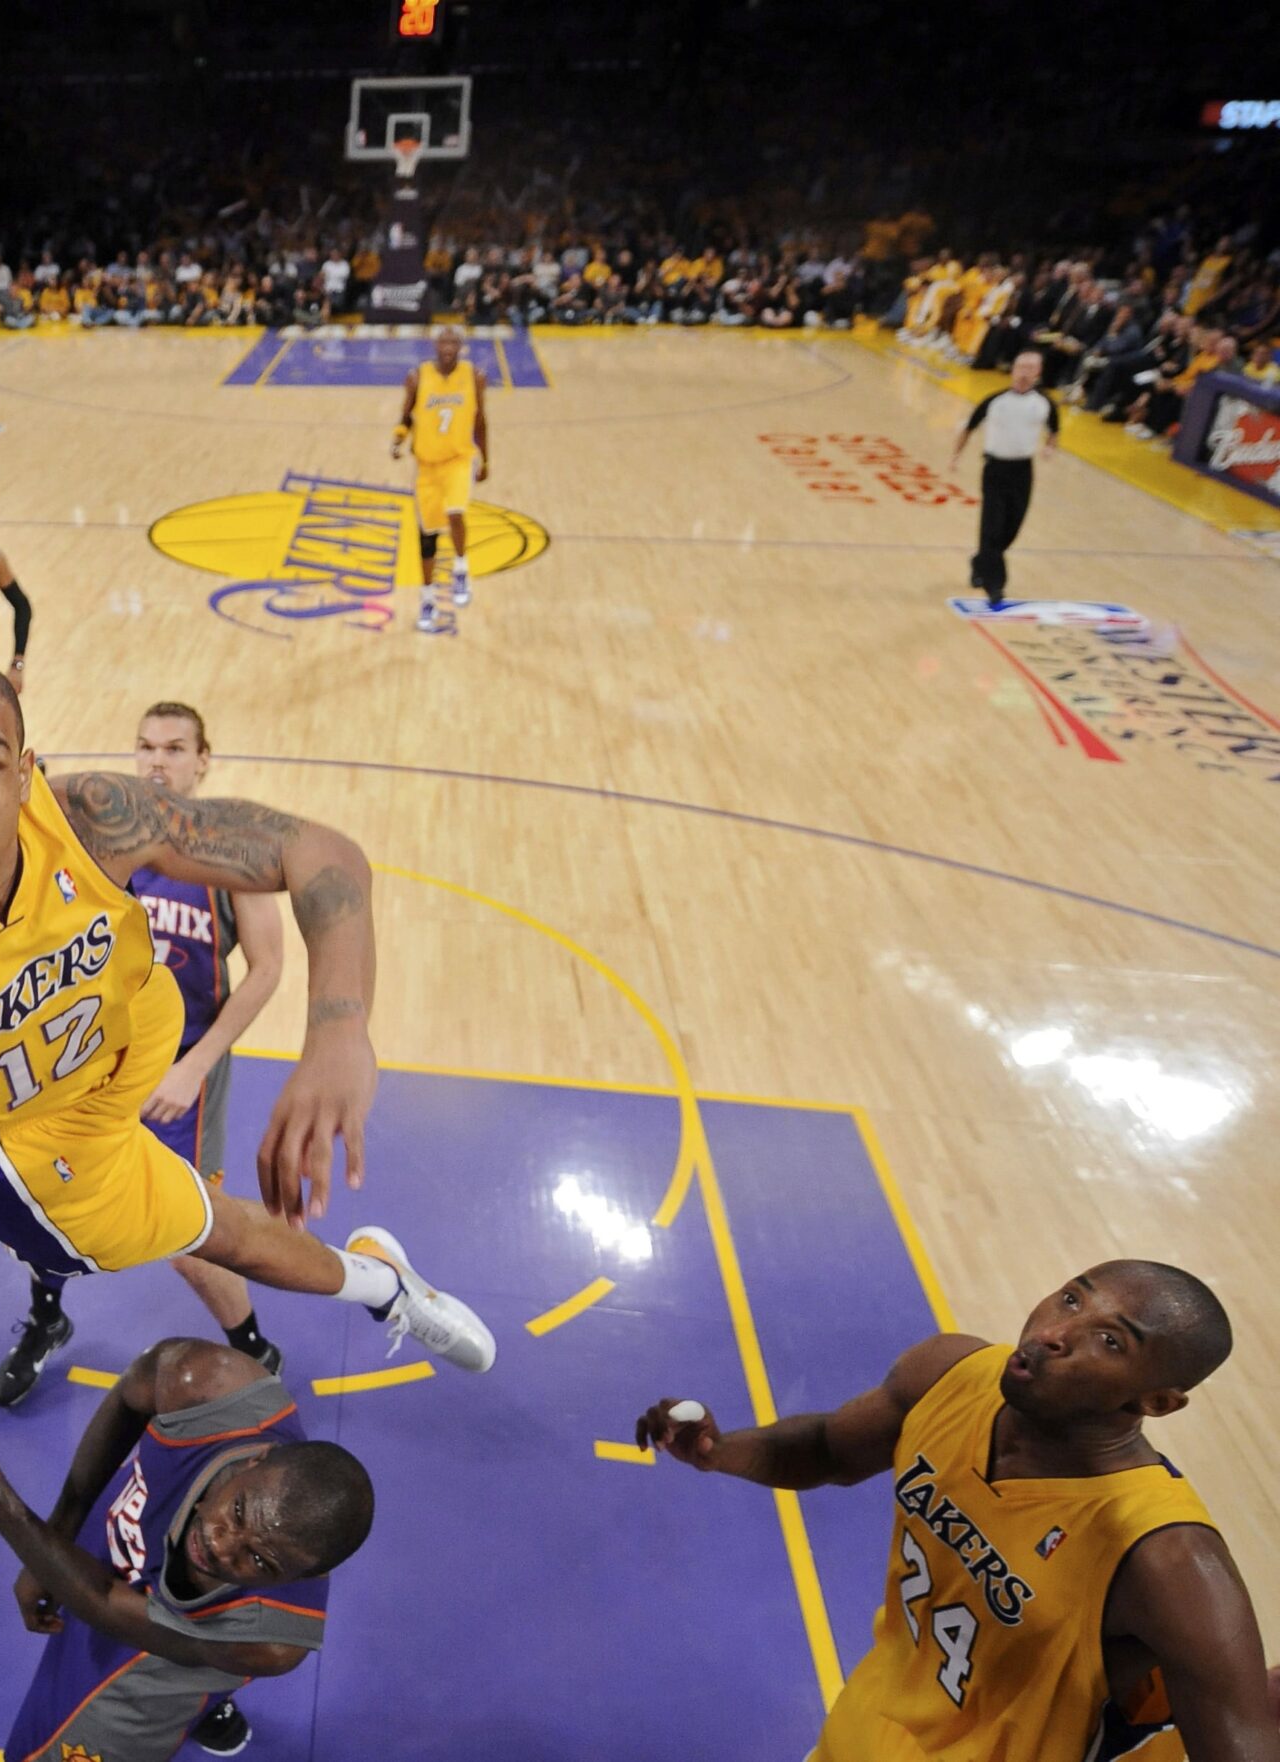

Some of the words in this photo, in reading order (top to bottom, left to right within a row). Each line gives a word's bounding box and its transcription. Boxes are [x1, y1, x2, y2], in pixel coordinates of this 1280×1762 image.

[438, 407, 453, 434] 7
[208, 467, 417, 640] LAKERS
[1090, 625, 1280, 783] WESTER
[140, 895, 213, 944] ENIX
[894, 1452, 1036, 1627] LAKERS
[899, 1526, 980, 1711] 24
